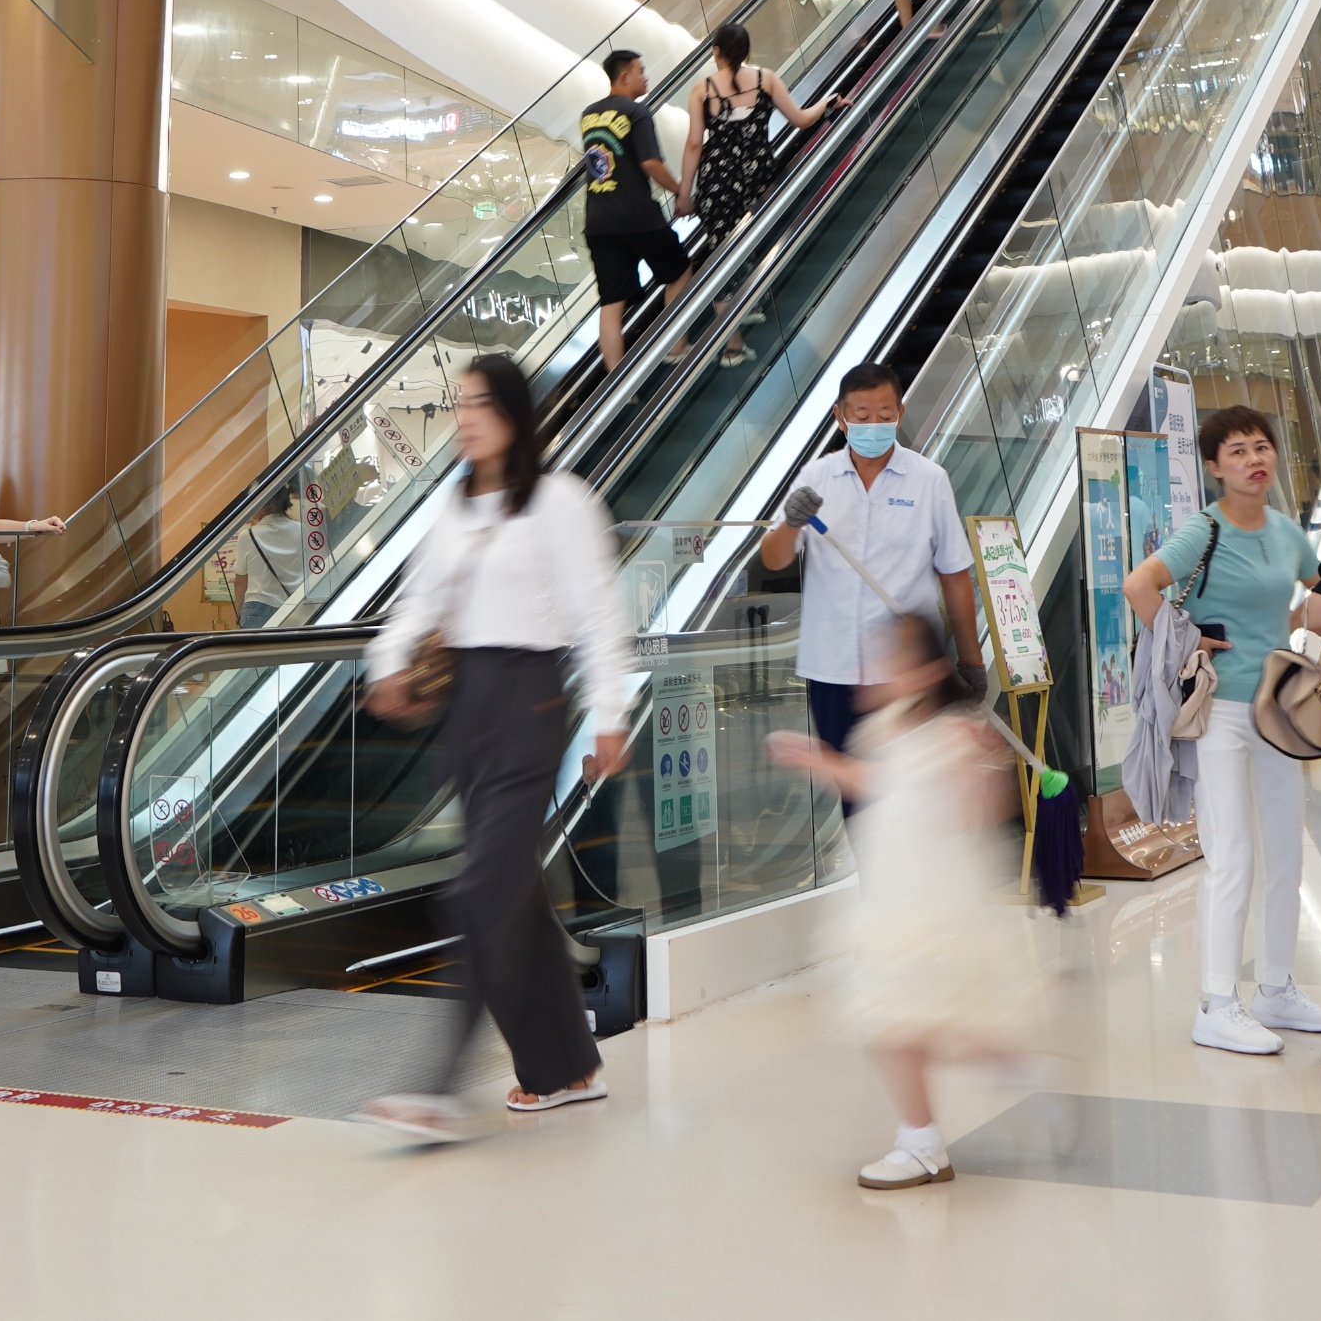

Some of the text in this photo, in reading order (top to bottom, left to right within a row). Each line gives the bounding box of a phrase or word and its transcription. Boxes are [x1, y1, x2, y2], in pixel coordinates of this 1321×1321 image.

[1096, 501, 1115, 529] 个人
[1097, 533, 1116, 561] 卫生
[636, 638, 669, 656] 小心玻璃
[232, 906, 258, 921] 26
